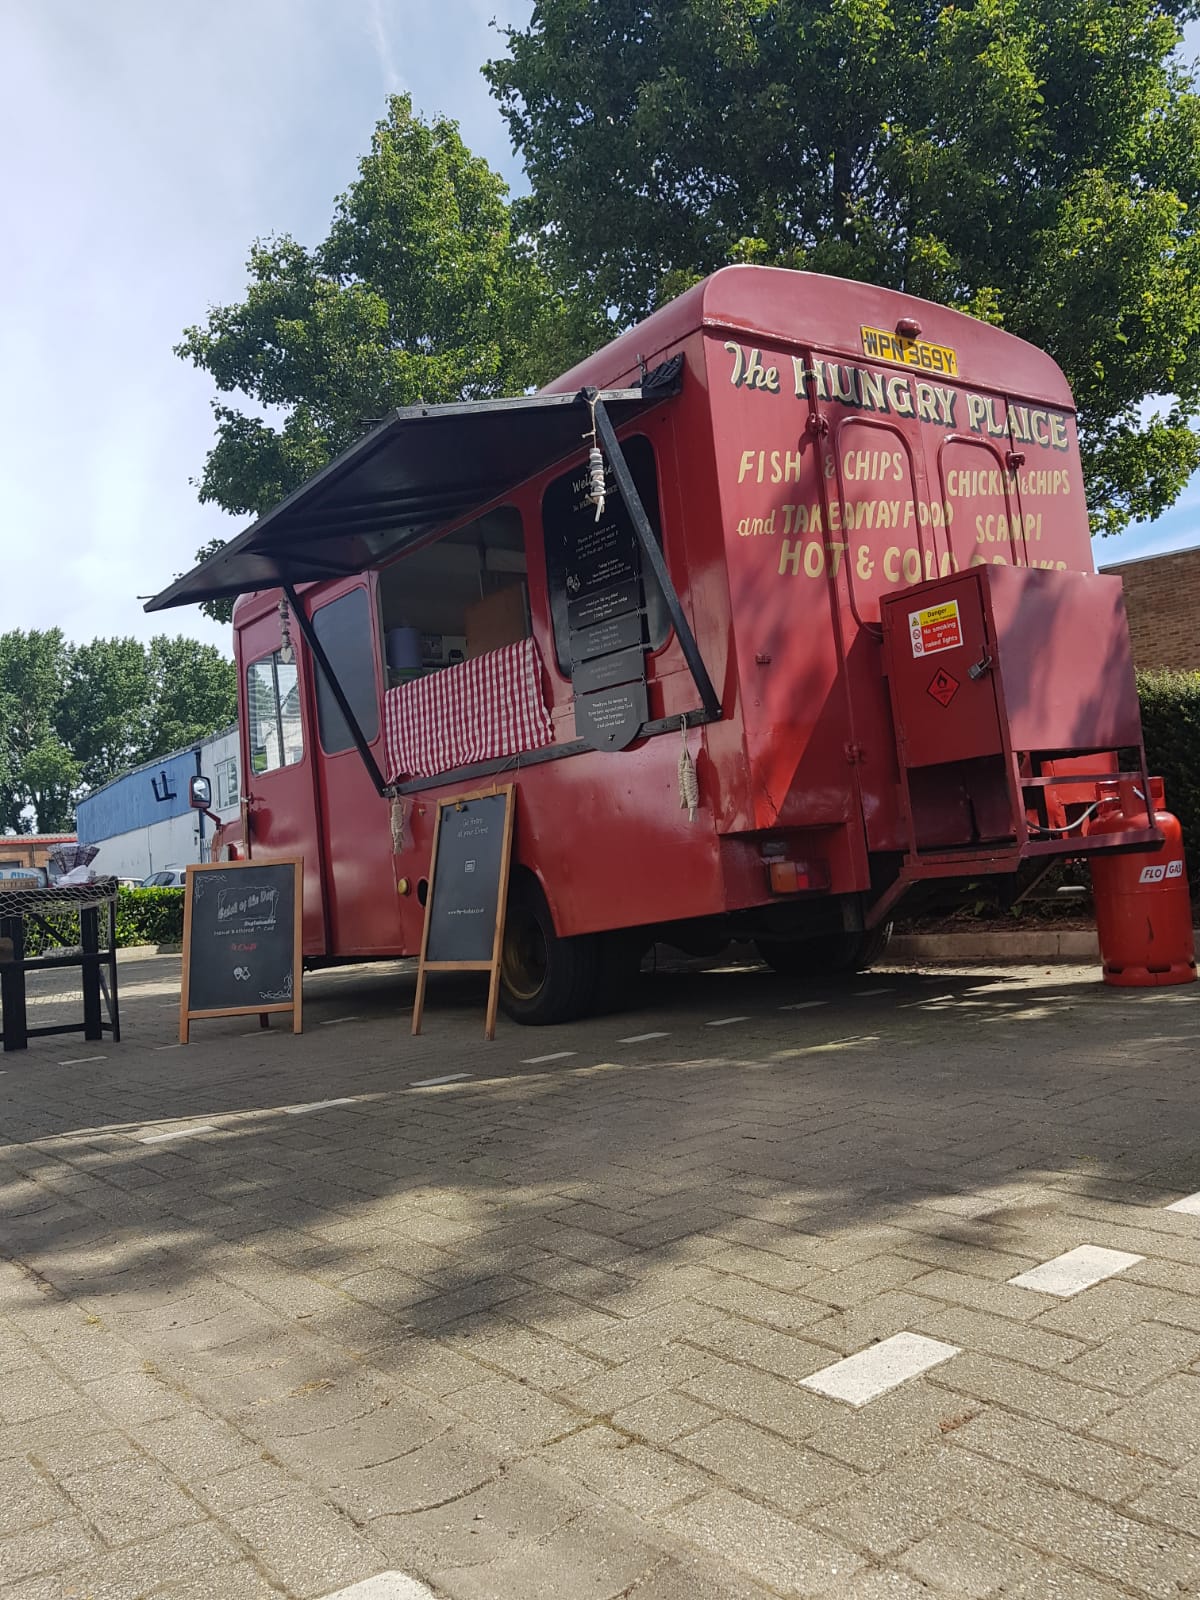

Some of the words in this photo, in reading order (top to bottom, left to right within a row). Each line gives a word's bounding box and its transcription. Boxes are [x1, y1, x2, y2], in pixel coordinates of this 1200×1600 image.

[865, 331, 905, 361] WPN
[908, 341, 953, 374] 369Y
[724, 341, 781, 394] The
[791, 355, 957, 428] HUNGRY
[966, 393, 1069, 452] PLAICE
[738, 450, 801, 484] FISH
[824, 454, 837, 479] &
[843, 450, 904, 481] CHIPS
[947, 470, 1020, 498] CHICKEN
[1028, 469, 1071, 495] CHIPS
[736, 509, 775, 536] and
[782, 500, 901, 534] TAKEAWAY
[903, 500, 954, 528] FOOD
[975, 512, 1042, 544] SCAMPI
[778, 539, 848, 578] HOT
[856, 545, 875, 580] &
[883, 546, 960, 584] COLD
[924, 627, 931, 635] No
[932, 622, 957, 633] smoking
[927, 608, 947, 618] Danger
[1144, 869, 1162, 879] FLO
